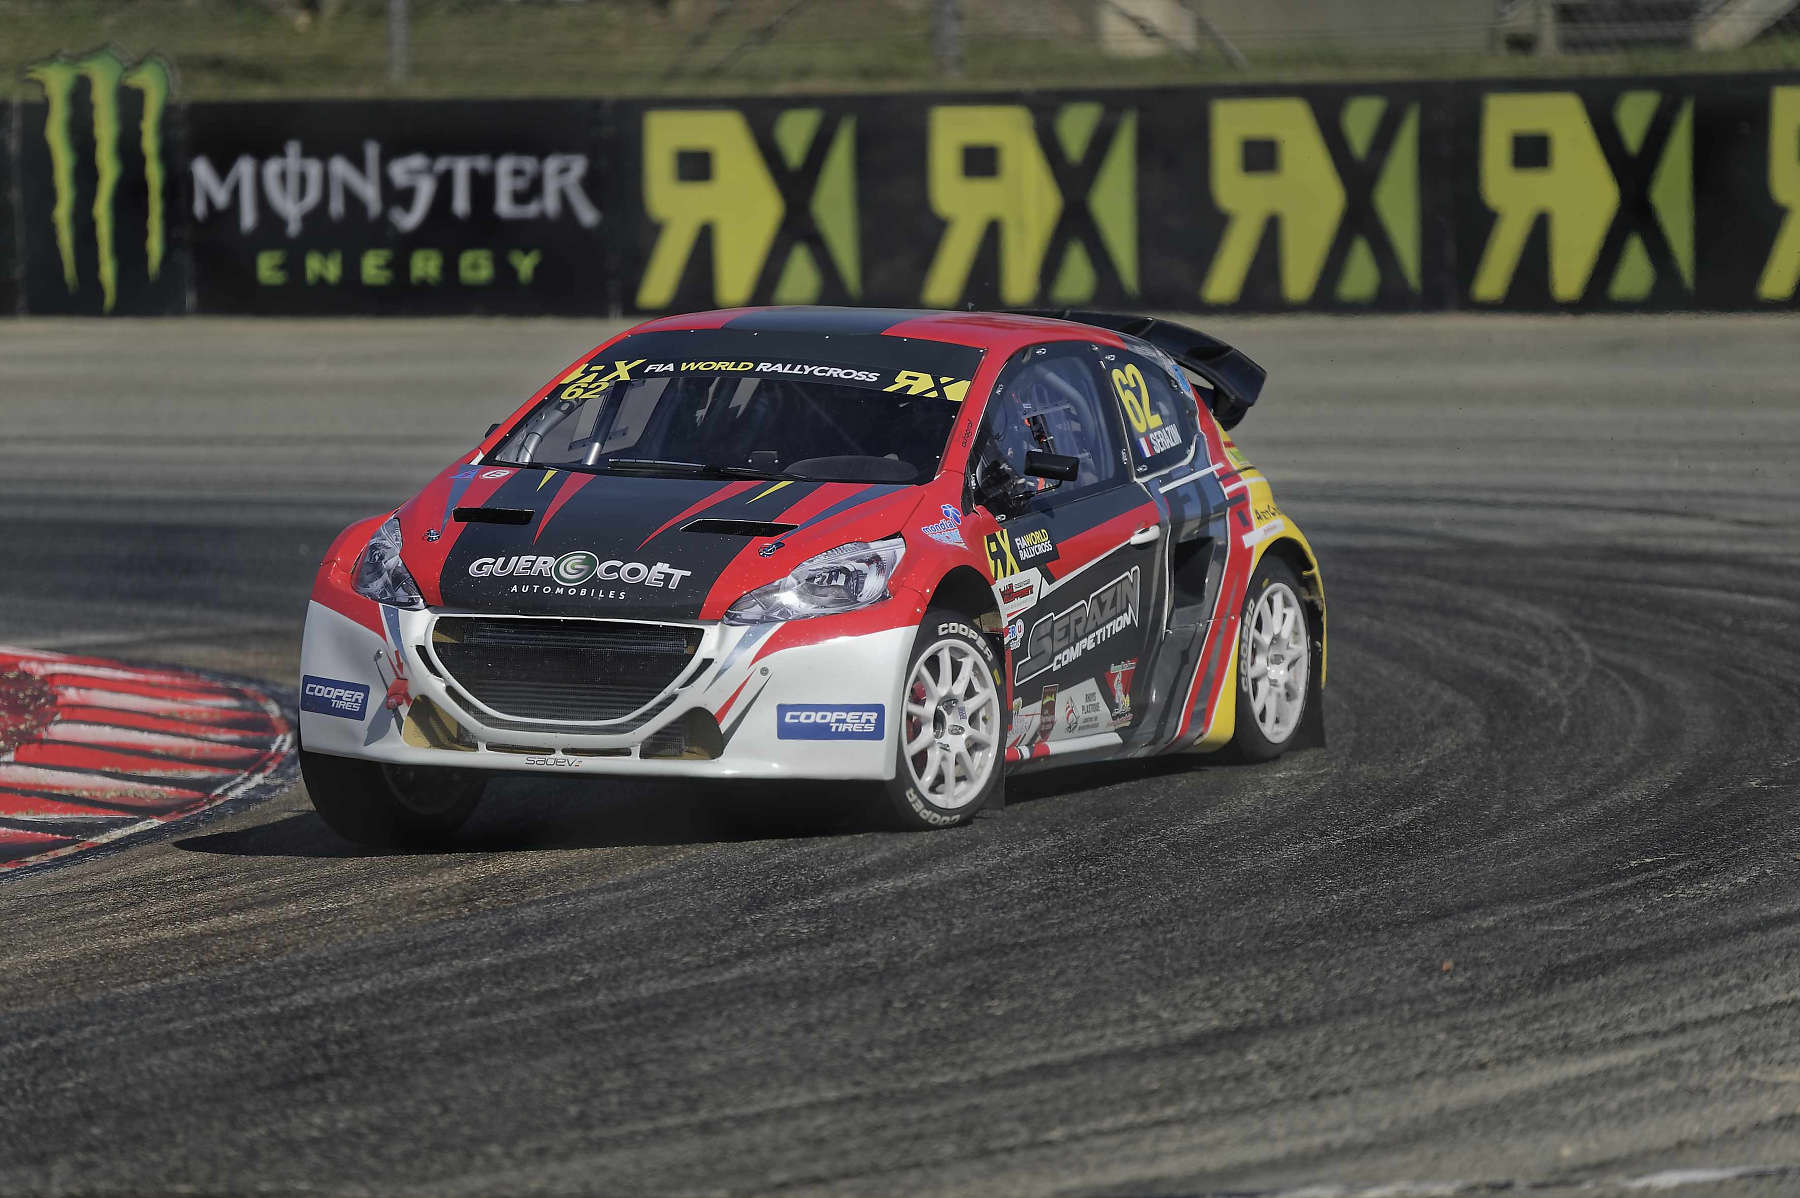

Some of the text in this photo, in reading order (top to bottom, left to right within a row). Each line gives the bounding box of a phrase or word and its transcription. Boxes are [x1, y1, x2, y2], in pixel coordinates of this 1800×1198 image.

[190, 139, 601, 238] MONSTER
[256, 248, 542, 286] ENERGY
[643, 362, 675, 373] FIA
[680, 361, 754, 372] WORLD
[756, 361, 881, 382] RALLYCROSS
[560, 381, 611, 400] 62
[1111, 363, 1163, 433] 62
[921, 518, 958, 535] mondial
[1018, 540, 1053, 561] RALLYCROSS
[468, 554, 555, 578] GUER
[510, 584, 626, 600] AUTOMOBILES
[1014, 565, 1141, 687] SERAZIN
[937, 622, 993, 662] COOPER
[1052, 611, 1137, 672] COMPETITION
[1240, 598, 1255, 692] COOPER
[305, 683, 365, 703] COOPER
[330, 699, 361, 712] TIRES
[784, 710, 878, 723] COOPER
[829, 722, 876, 732] TIRES
[905, 787, 961, 825] COOPER
